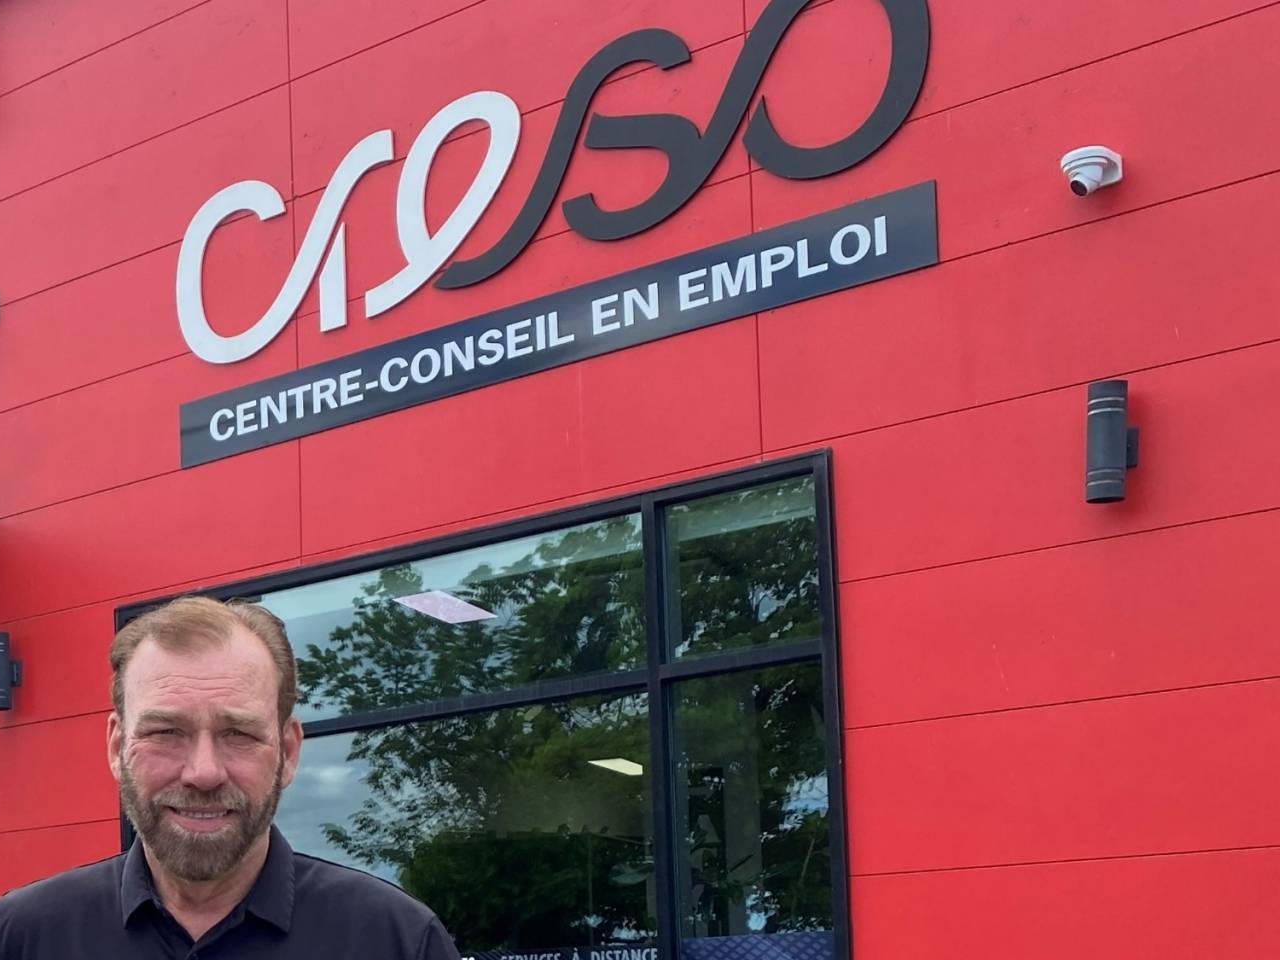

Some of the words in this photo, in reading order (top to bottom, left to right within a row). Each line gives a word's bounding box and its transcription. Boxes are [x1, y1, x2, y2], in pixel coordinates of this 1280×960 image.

[209, 311, 575, 441] CENTRE-CONSEIL
[591, 282, 659, 335] EN
[678, 215, 888, 311] EMPLOI
